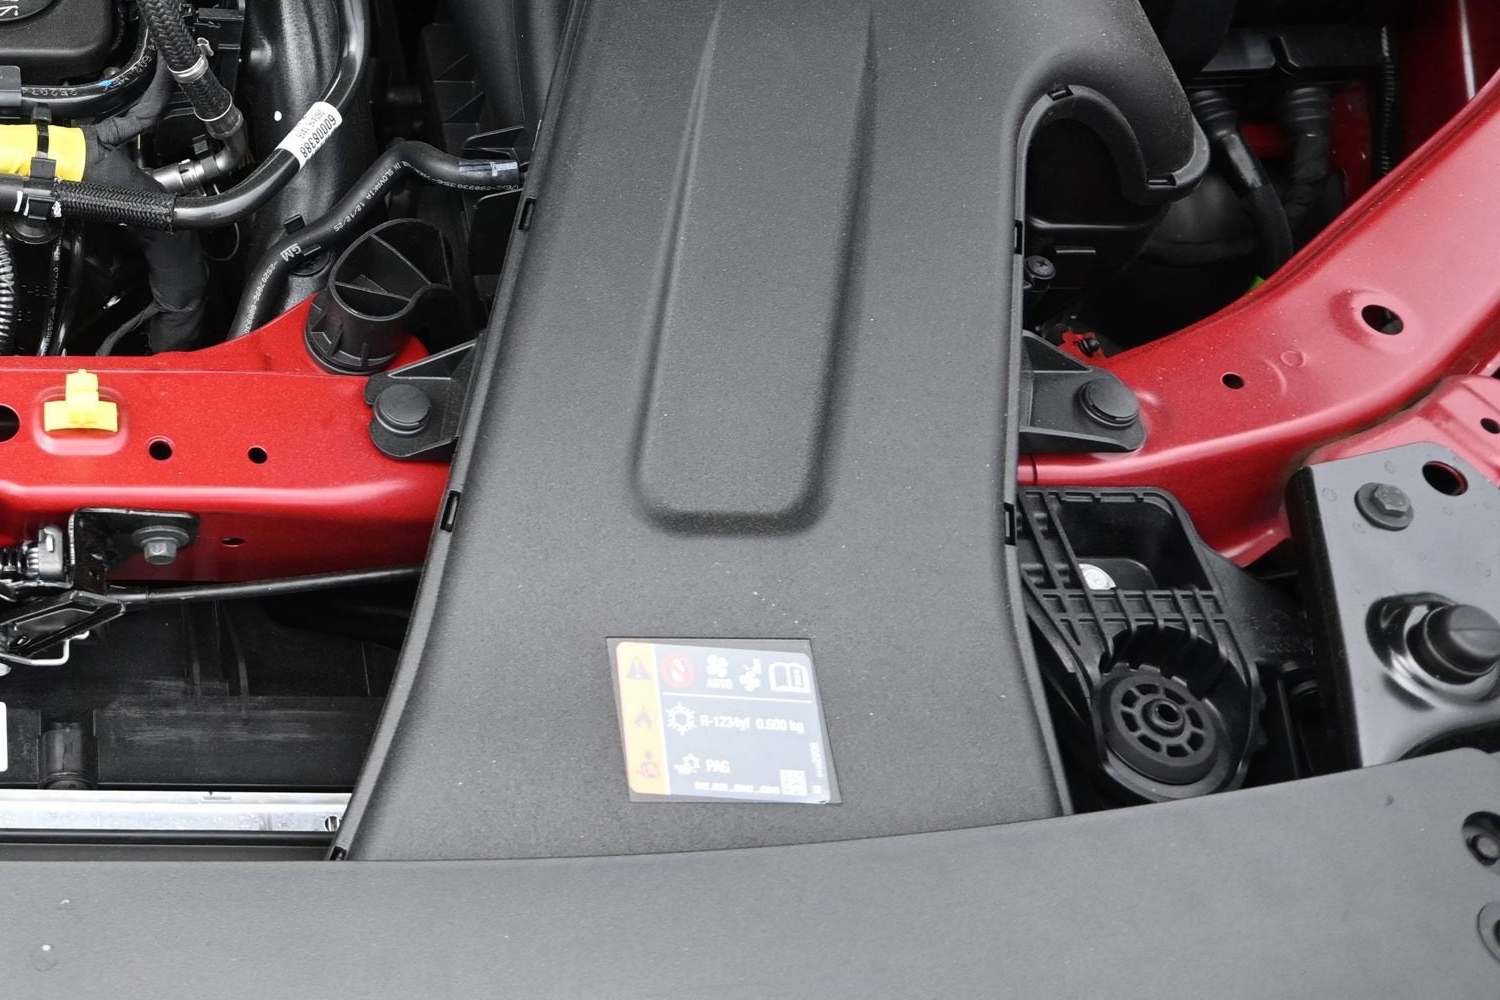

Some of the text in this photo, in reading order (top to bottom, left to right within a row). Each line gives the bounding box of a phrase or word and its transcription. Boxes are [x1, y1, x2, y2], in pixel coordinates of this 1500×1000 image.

[300, 114, 337, 159] 60008388
[365, 170, 395, 200] SLOVAKIA
[280, 244, 301, 262] GM
[789, 719, 805, 734] kg
[706, 759, 731, 773] PAG
